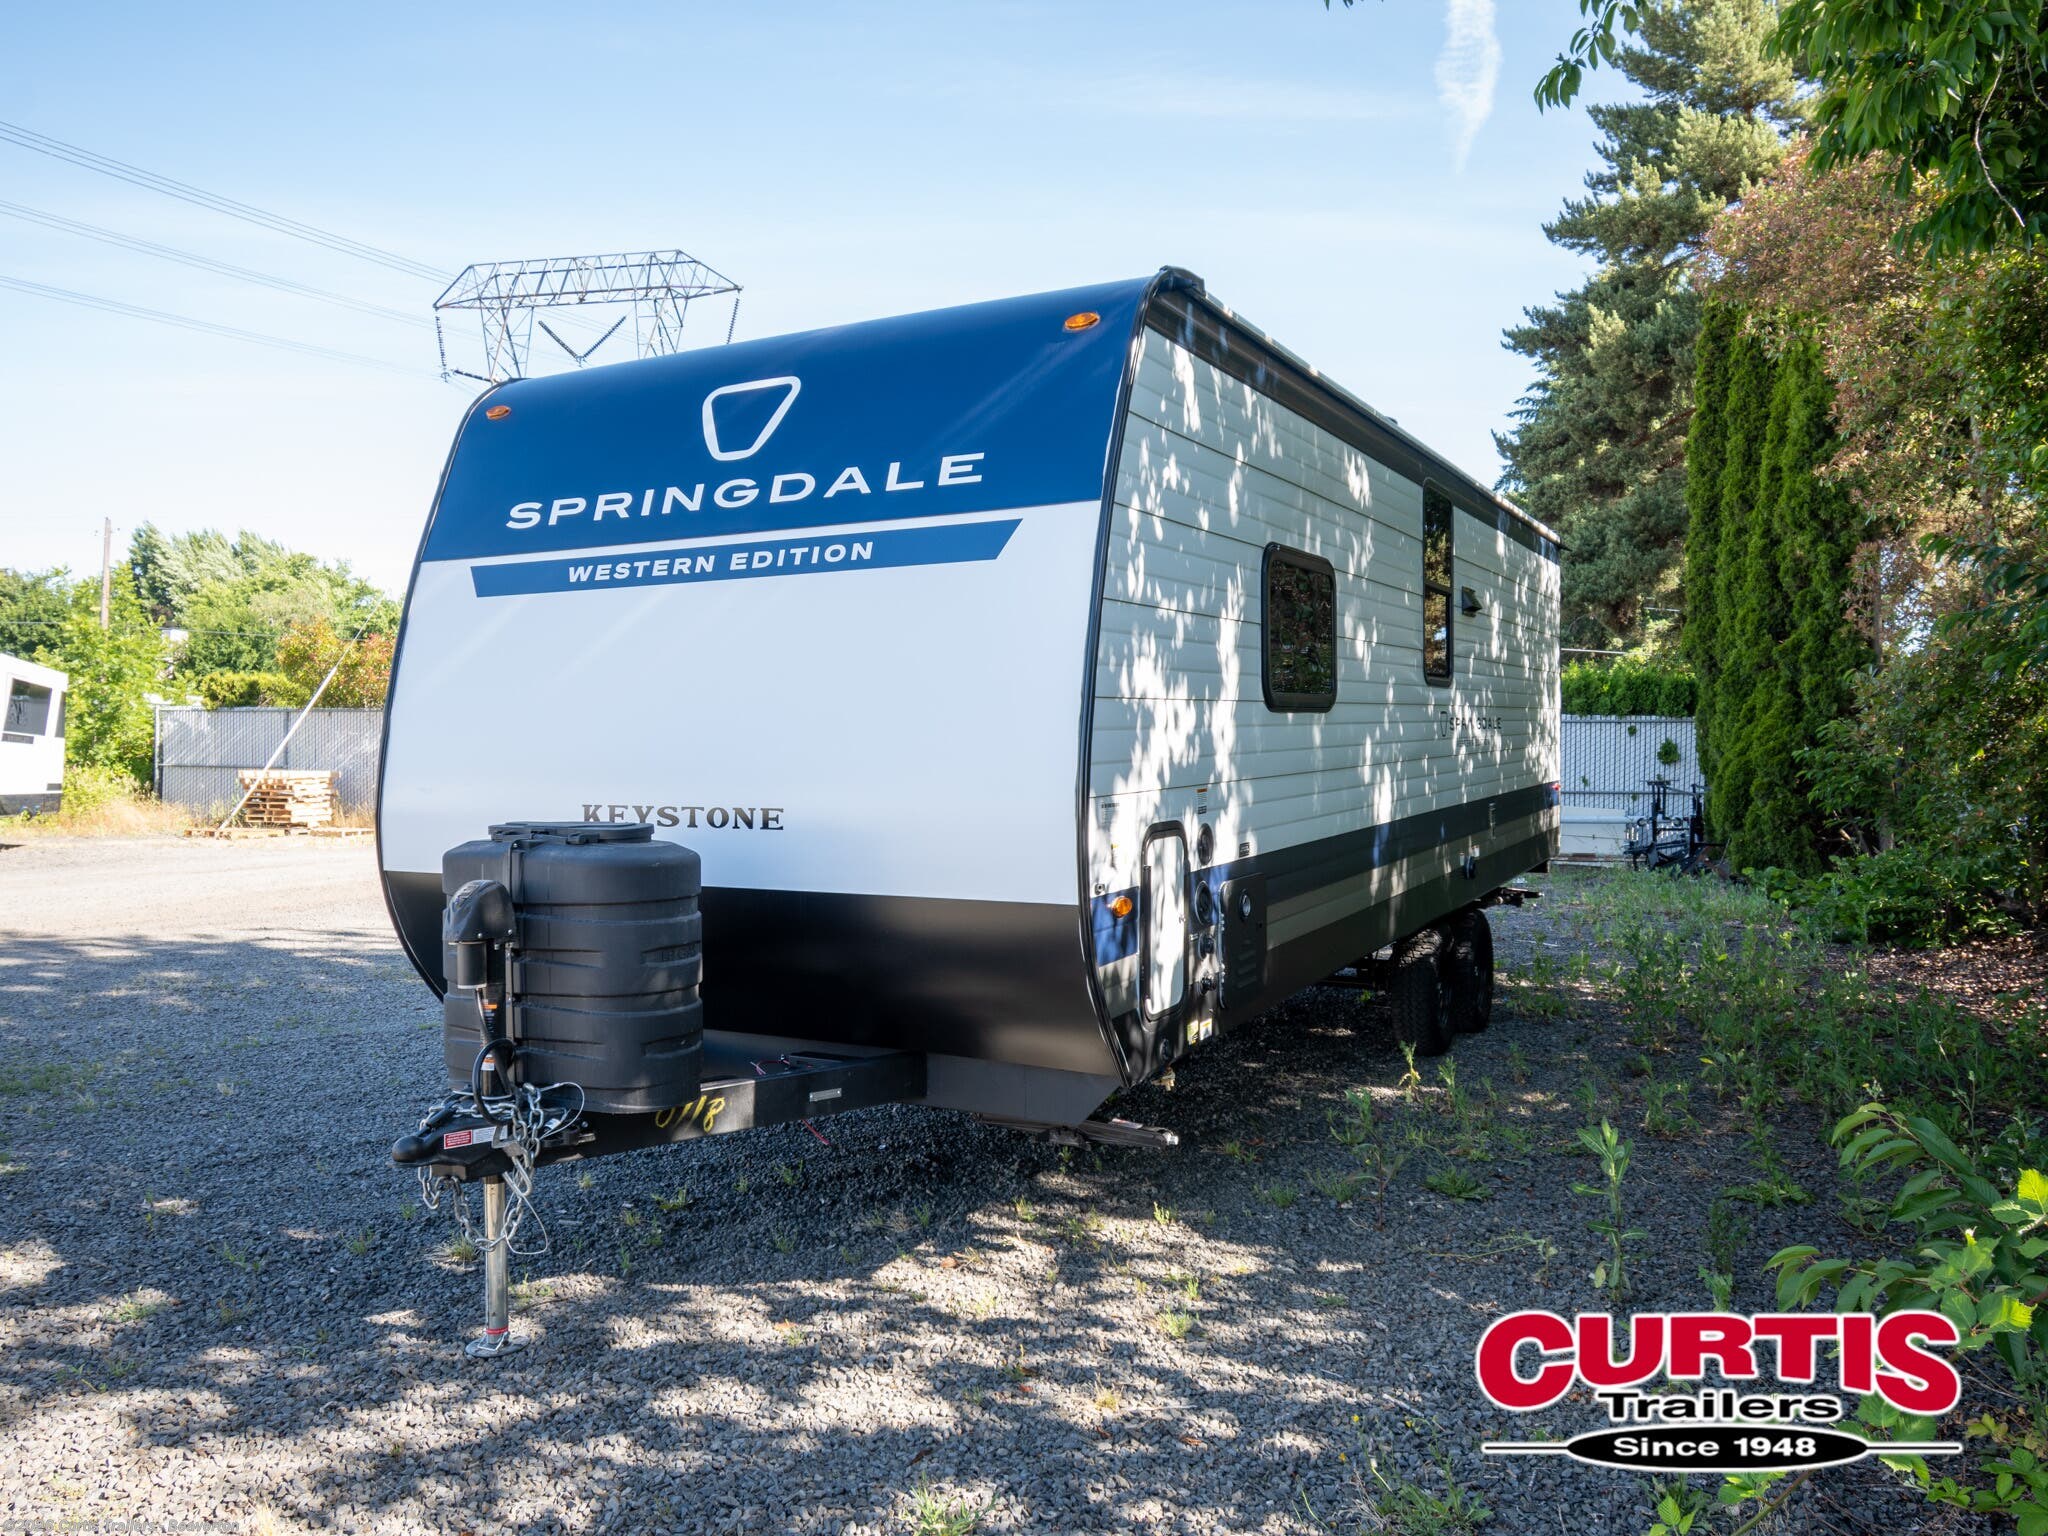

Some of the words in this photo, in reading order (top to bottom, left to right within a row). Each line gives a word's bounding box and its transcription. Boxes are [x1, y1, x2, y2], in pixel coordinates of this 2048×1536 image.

[505, 452, 985, 530] SPRINGDALE
[568, 554, 716, 583] WESTERN
[729, 541, 873, 571] EDITION
[582, 804, 784, 831] KEYSTONE
